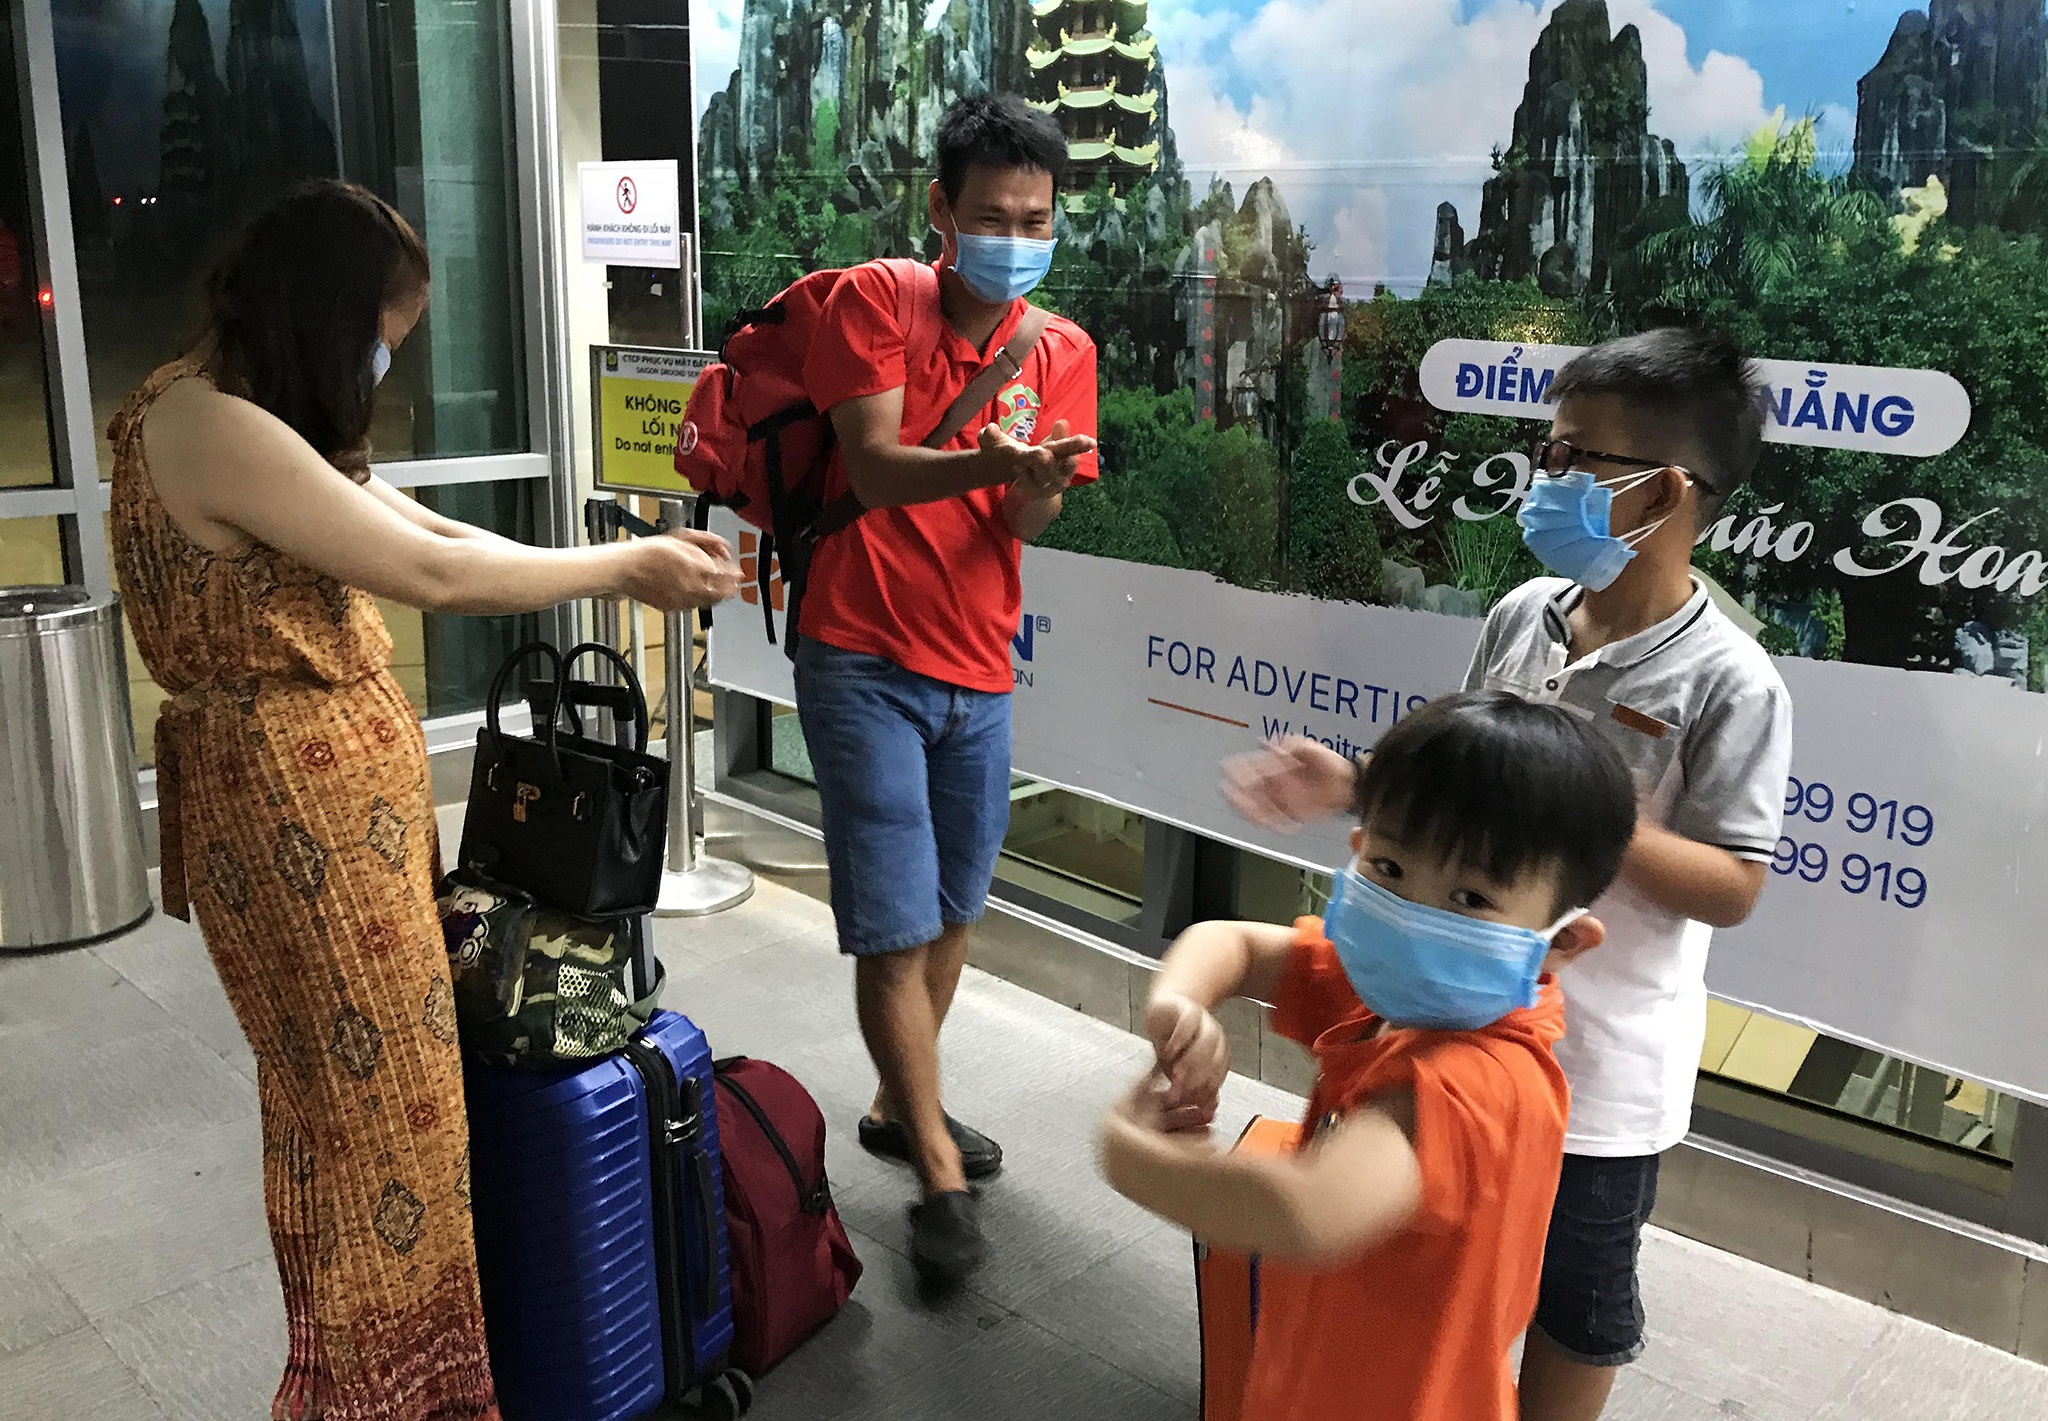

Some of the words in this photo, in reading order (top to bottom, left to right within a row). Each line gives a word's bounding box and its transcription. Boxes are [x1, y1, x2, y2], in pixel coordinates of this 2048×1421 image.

[625, 393, 682, 415] KHÔNG
[1456, 347, 1555, 405] ĐIỂM
[1760, 369, 1915, 438] NẴNG
[616, 437, 632, 451] Do
[633, 440, 652, 454] not
[642, 415, 665, 437] LỐI
[1346, 440, 1461, 530] Lễ
[1148, 635, 1216, 684] FOR
[1846, 792, 1934, 847] 919
[1840, 853, 1928, 909] 919
